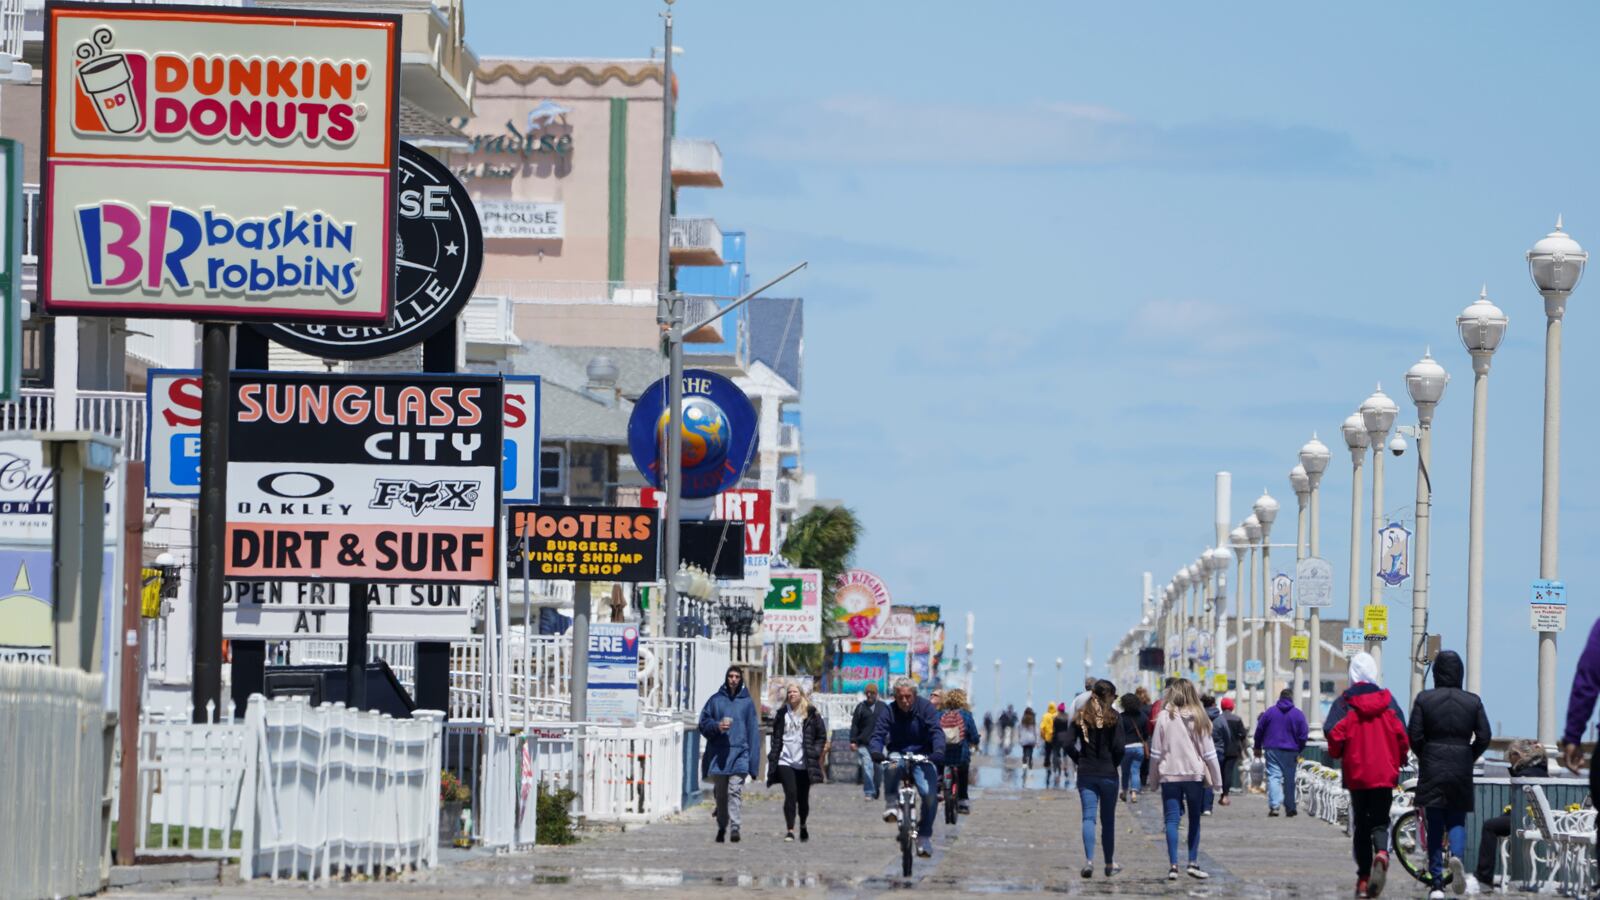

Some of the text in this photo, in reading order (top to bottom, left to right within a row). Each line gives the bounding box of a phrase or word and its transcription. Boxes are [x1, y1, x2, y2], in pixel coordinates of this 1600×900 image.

[154, 56, 368, 99] DUNKIN'
[154, 97, 356, 141] DONUTS
[238, 383, 482, 426] SUNGLASS
[364, 431, 482, 461] CITY
[238, 502, 352, 516] OAKLEY
[515, 511, 652, 541] HOOTERS
[231, 528, 484, 573] DIRT & SURF
[521, 552, 643, 564] WINGS SHRIMP
[546, 540, 618, 552] BURGERS
[541, 562, 623, 575] GIFT SHOP
[298, 583, 335, 605] FRI
[411, 584, 462, 606] SUN
[294, 611, 326, 633] AT
